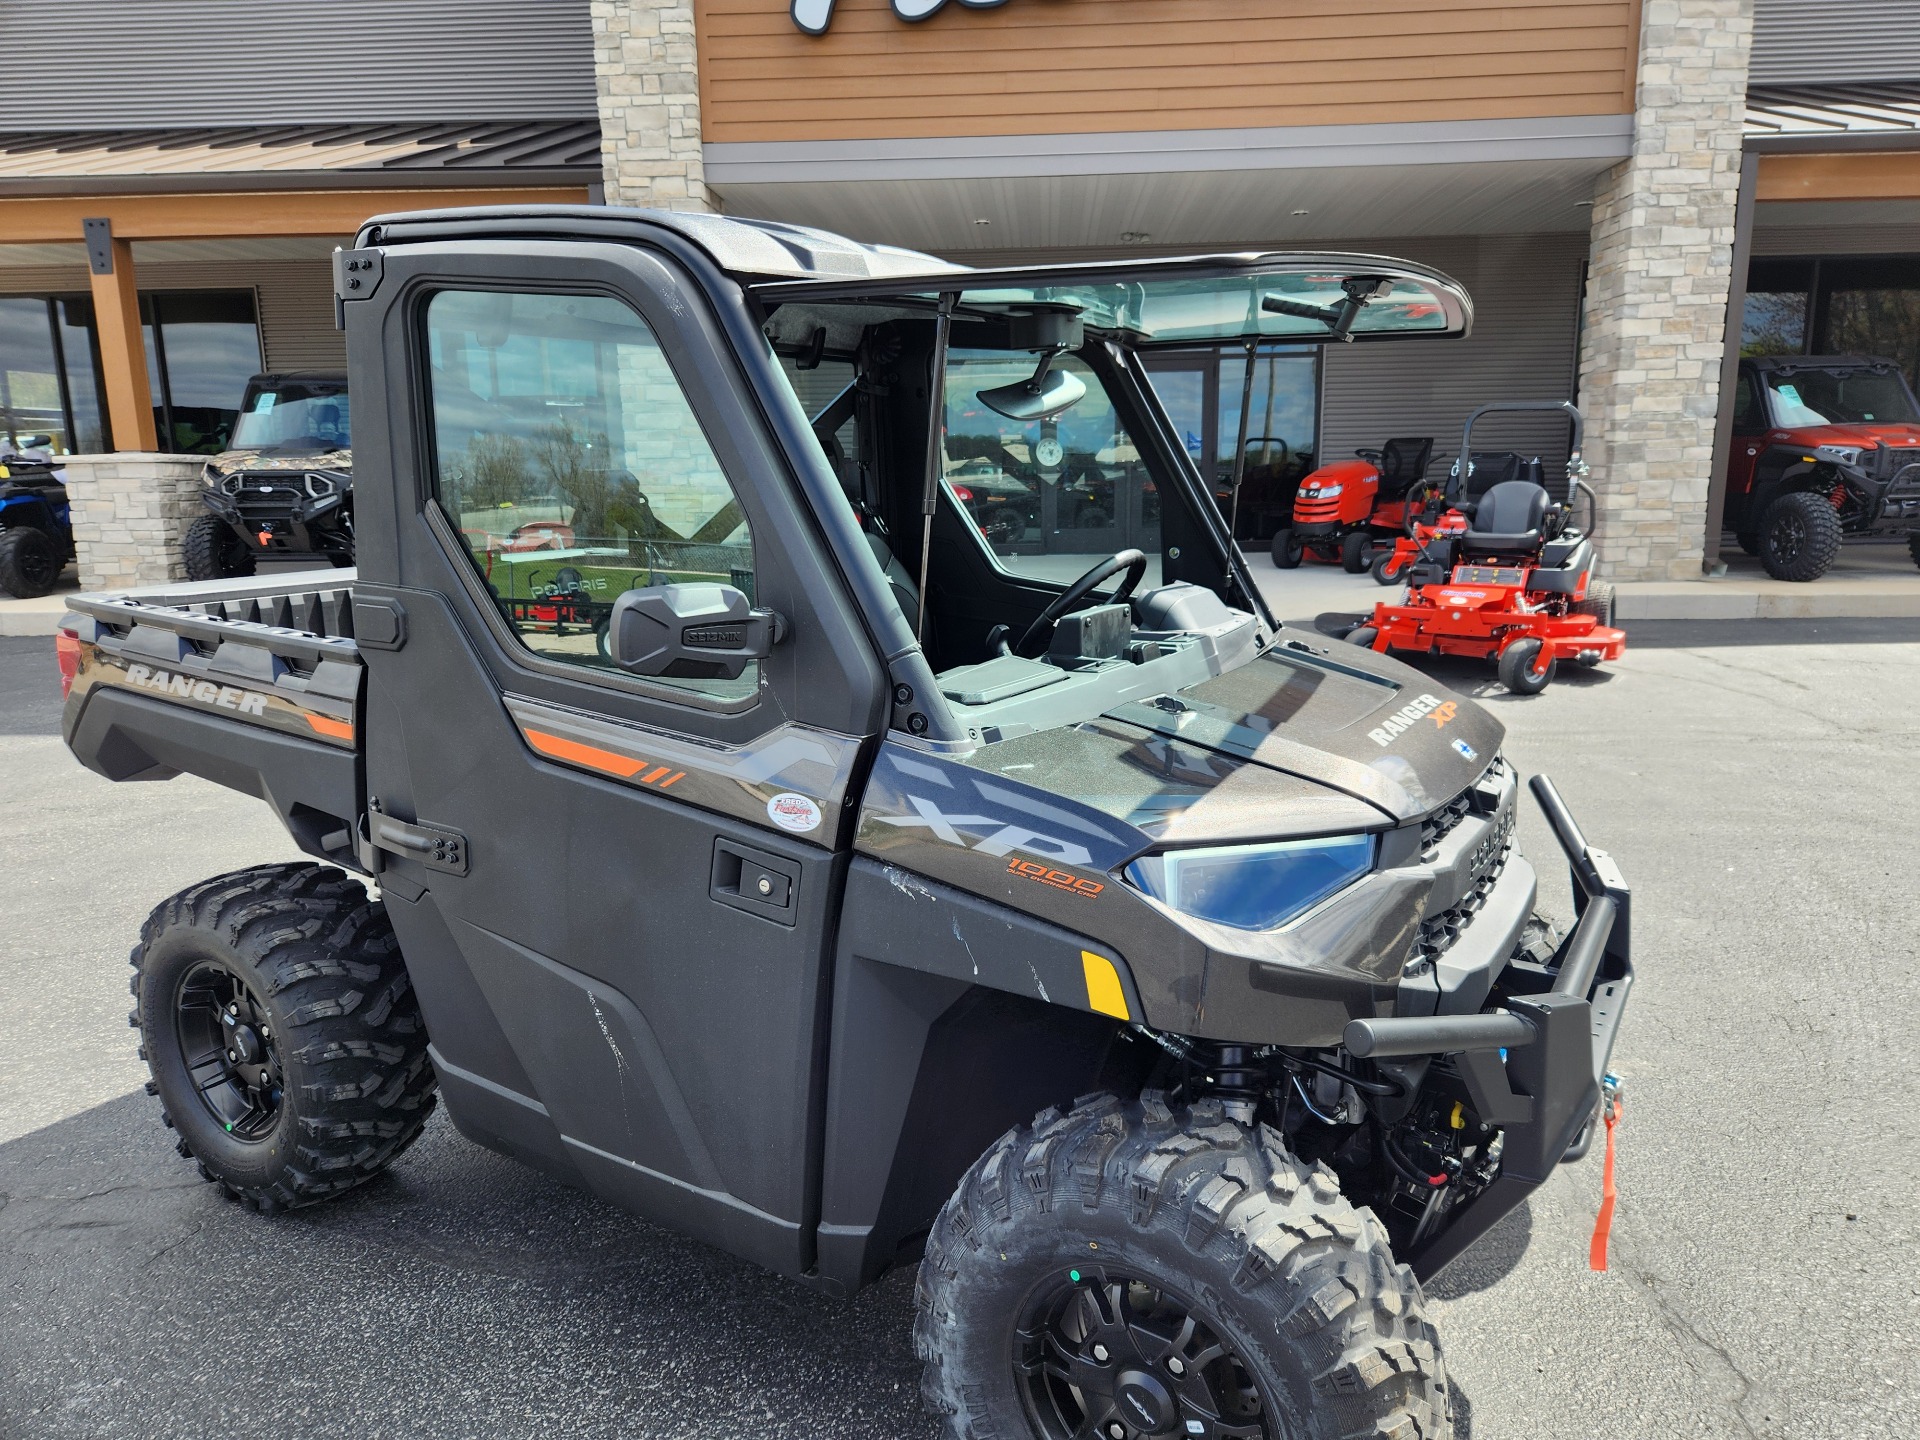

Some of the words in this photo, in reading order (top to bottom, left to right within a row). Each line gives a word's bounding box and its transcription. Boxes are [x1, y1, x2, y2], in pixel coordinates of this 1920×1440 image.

[530, 578, 608, 600] POLARIS
[687, 631, 742, 643] SEIZMIK
[124, 663, 269, 716] RANGER
[1367, 693, 1442, 748] RANGER
[1426, 700, 1458, 729] XP
[872, 794, 1093, 866] XP
[1006, 867, 1029, 878] DUAL
[1030, 875, 1077, 893] OVERHEAD
[1077, 890, 1098, 900] CAM
[1008, 857, 1106, 894] 1000
